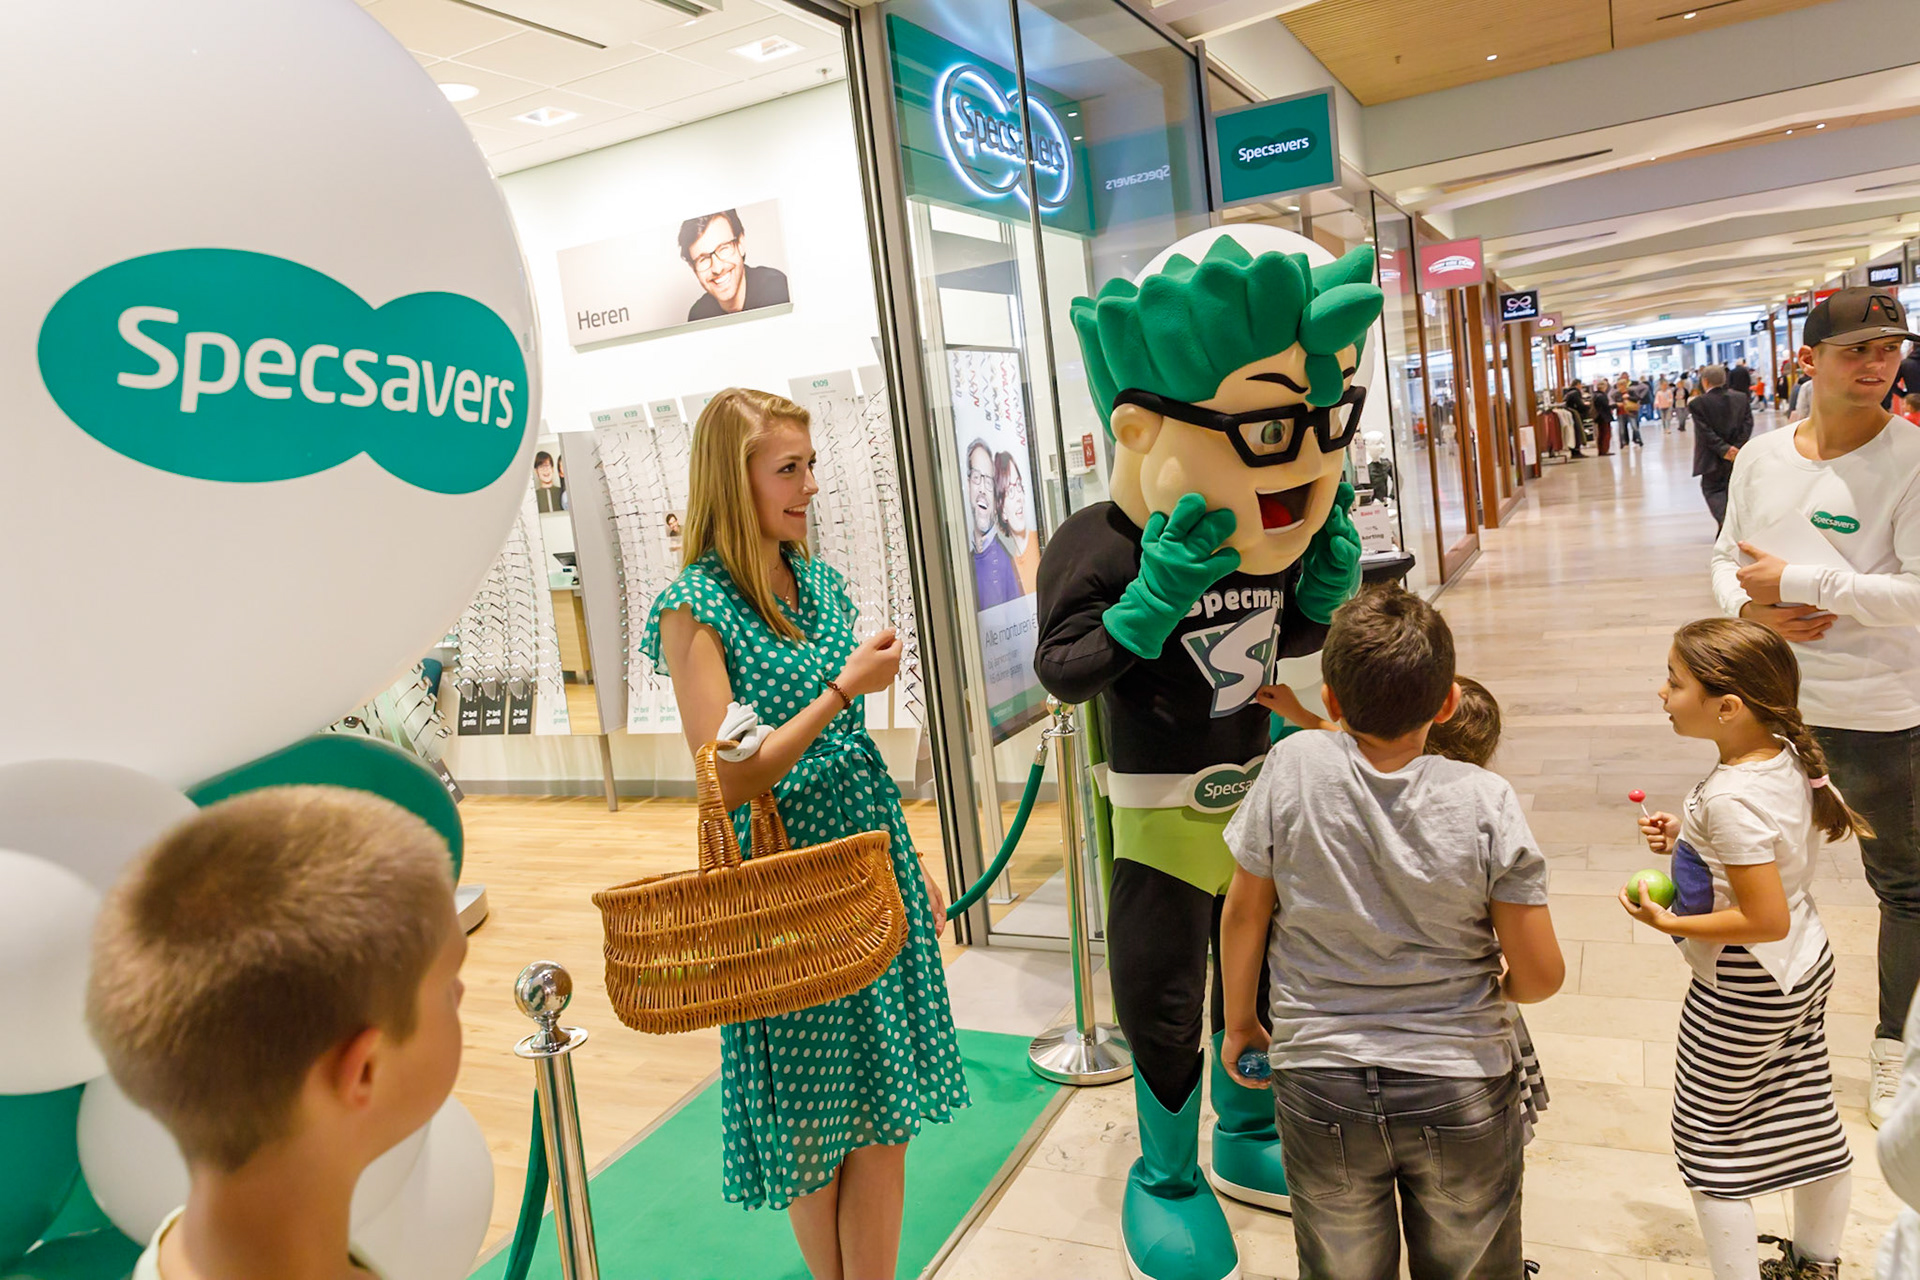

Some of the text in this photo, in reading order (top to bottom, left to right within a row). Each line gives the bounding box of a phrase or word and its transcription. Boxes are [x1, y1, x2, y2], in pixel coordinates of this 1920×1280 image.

[1238, 137, 1310, 163] Specsavers
[577, 306, 630, 330] Heren
[116, 305, 515, 429] Specsavers
[1812, 514, 1856, 530] Specsavers
[985, 630, 999, 648] Alle
[462, 718, 477, 728] gratis
[486, 718, 501, 727] gratis
[513, 717, 528, 726] gratis
[1203, 779, 1256, 800] Specsa
